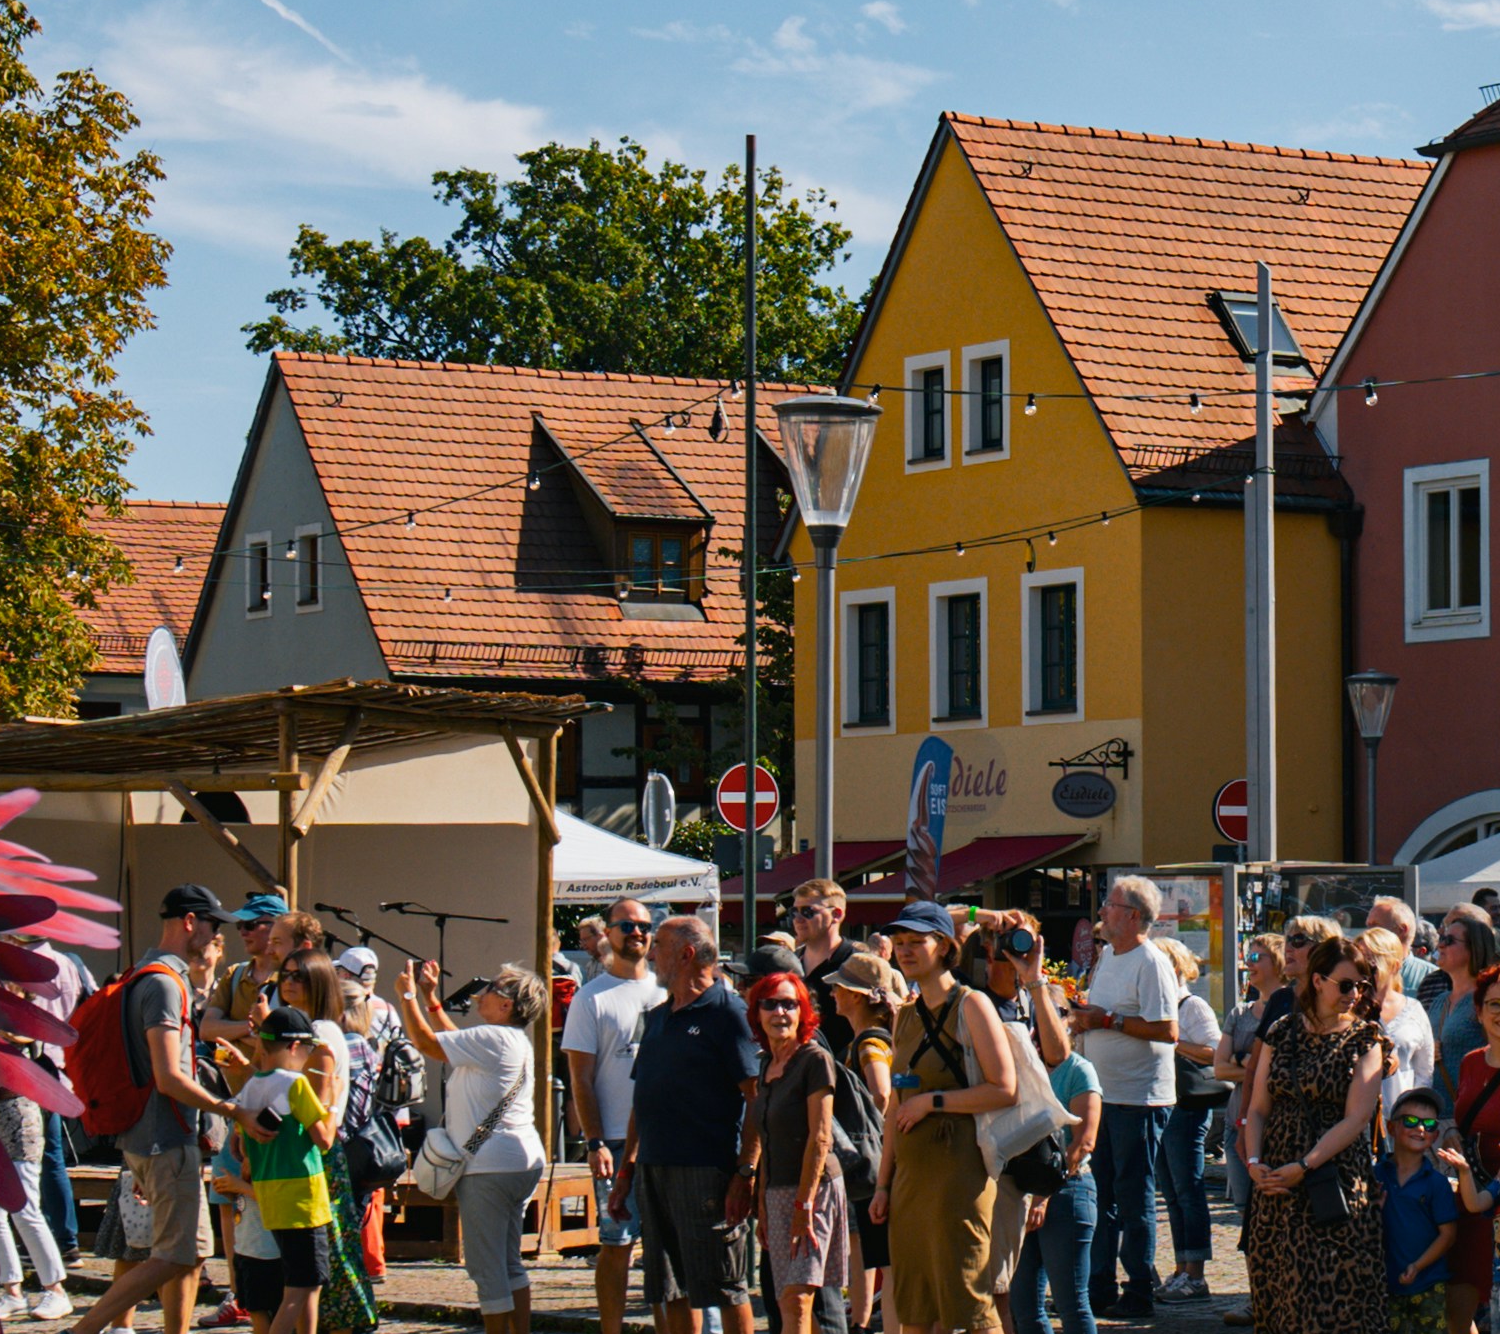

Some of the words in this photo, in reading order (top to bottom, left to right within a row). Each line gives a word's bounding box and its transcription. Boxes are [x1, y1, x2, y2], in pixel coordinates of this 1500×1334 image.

[951, 755, 1008, 797] diele
[930, 783, 947, 796] SOFT
[1060, 783, 1109, 801] Eisdiele
[930, 797, 947, 815] EIS
[566, 882, 623, 893] Astroclub
[626, 878, 677, 891] Radebeul
[680, 876, 702, 888] e.V.
